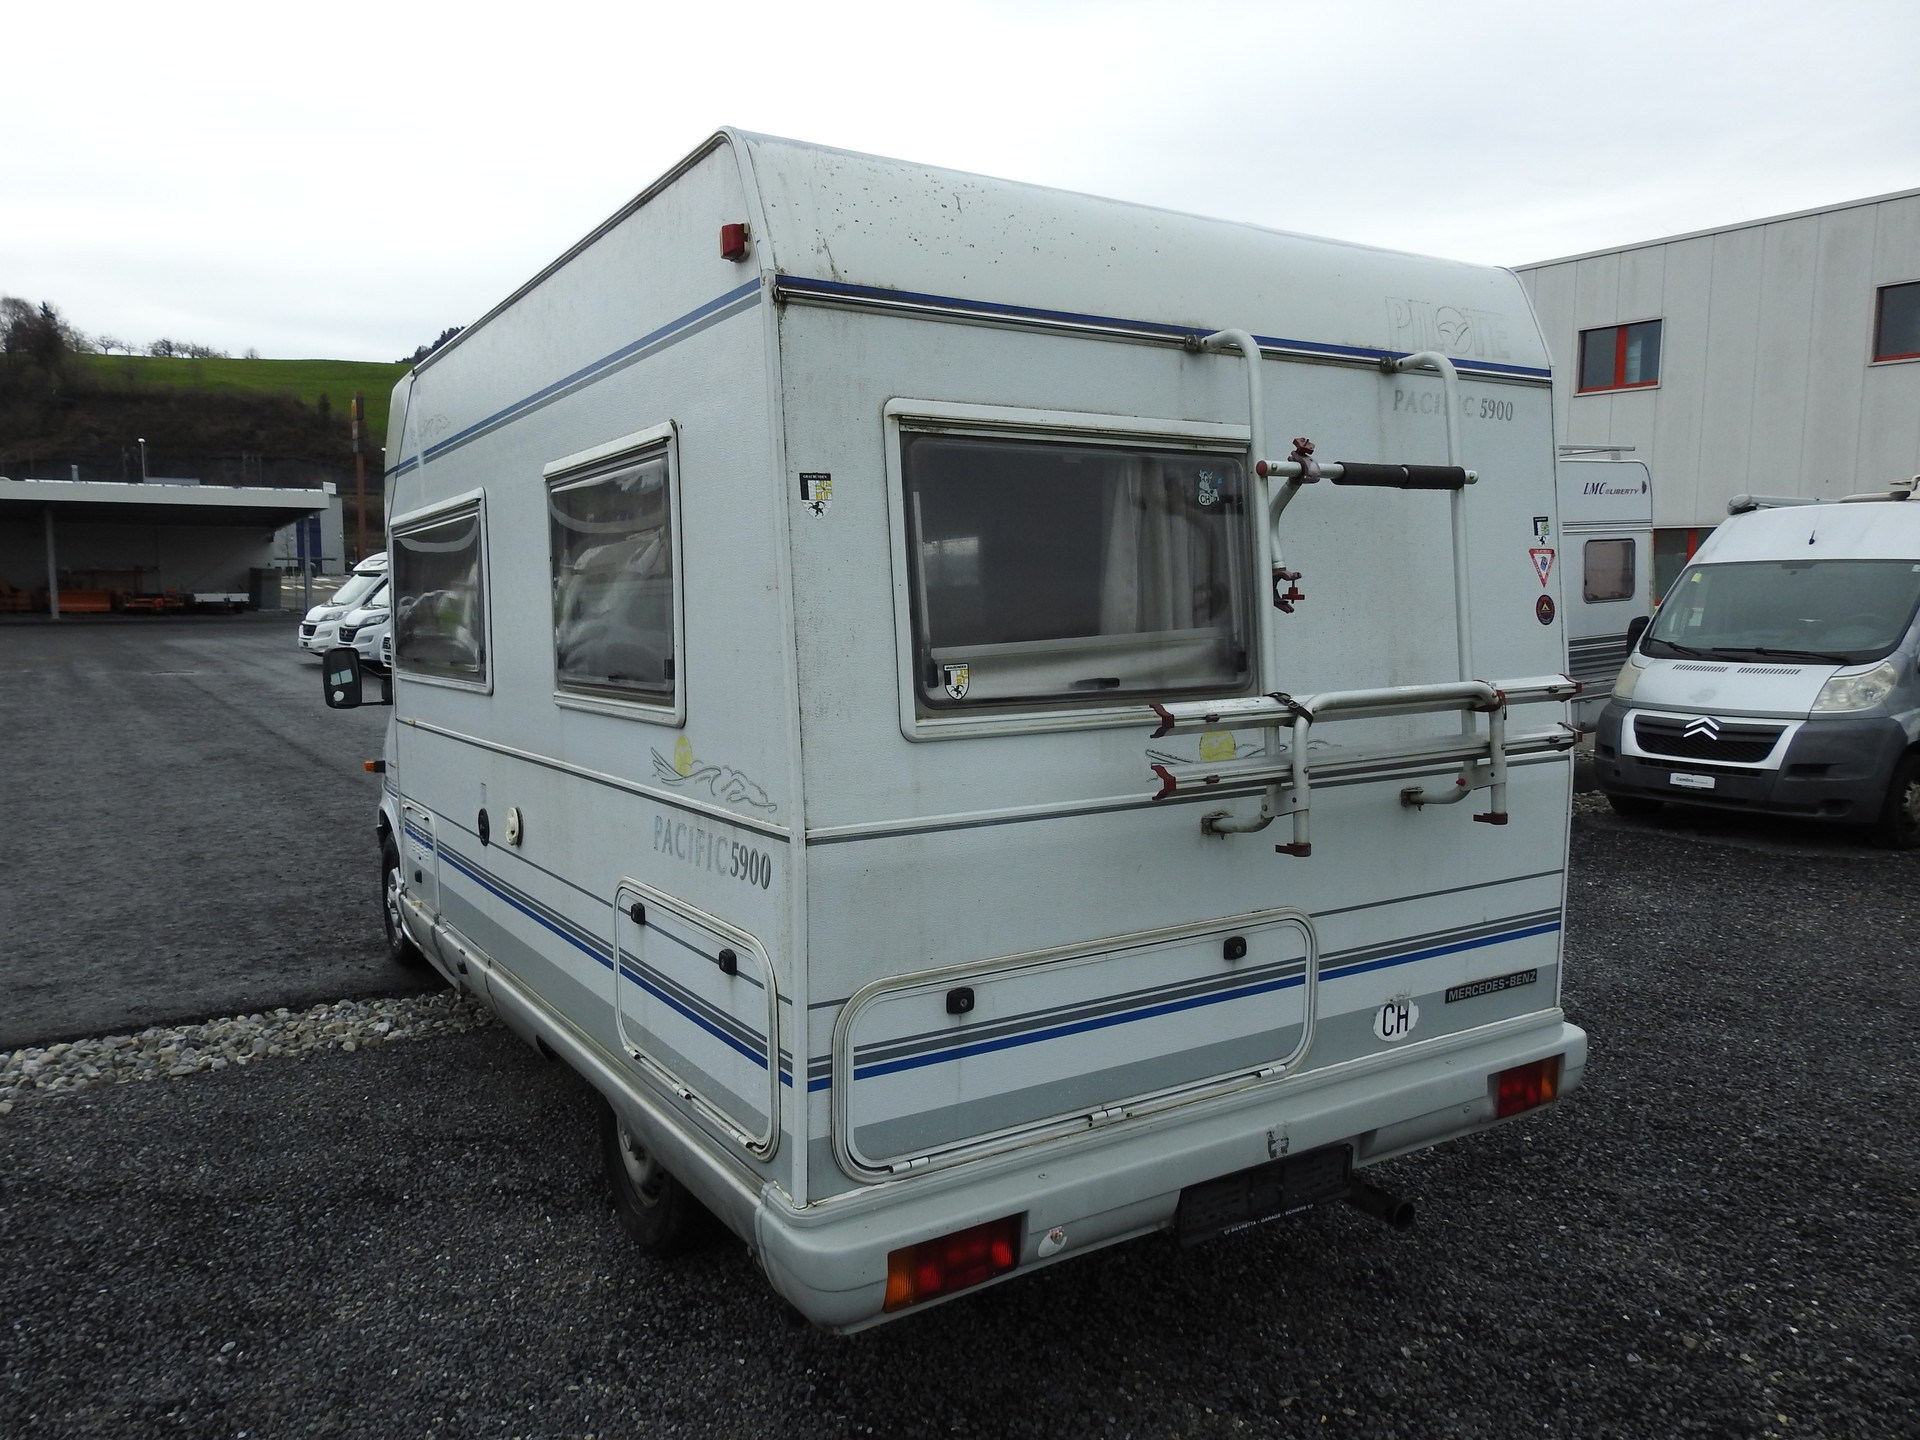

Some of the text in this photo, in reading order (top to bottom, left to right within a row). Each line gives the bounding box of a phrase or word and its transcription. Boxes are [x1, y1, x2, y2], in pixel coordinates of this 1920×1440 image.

[1480, 398, 1513, 421] 5900
[1584, 482, 1607, 495] LMC
[654, 815, 772, 890] PACIFIC 5900
[1449, 971, 1537, 1001] MERCEDES-BENZ
[1382, 1003, 1409, 1036] CH
[1261, 1213, 1281, 1223] GARAGE
